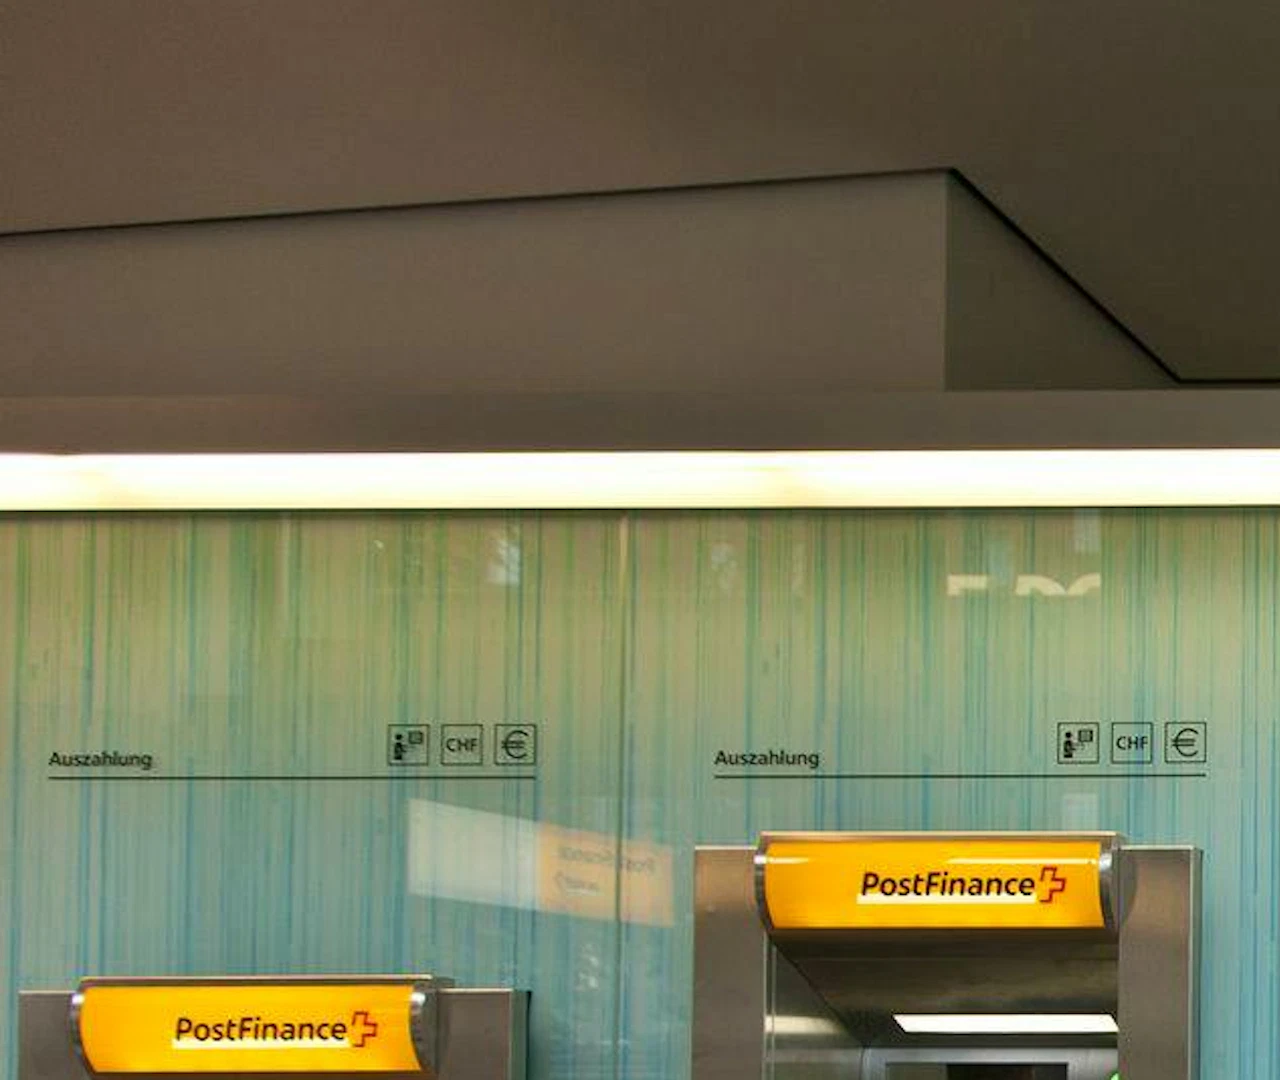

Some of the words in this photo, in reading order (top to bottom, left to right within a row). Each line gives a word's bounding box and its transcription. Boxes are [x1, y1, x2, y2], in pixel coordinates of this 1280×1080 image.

[445, 737, 479, 753] CHF
[1116, 735, 1149, 751] CHF
[48, 749, 153, 770] Auszahlung
[714, 748, 820, 770] Auszahlung
[861, 871, 1035, 897] PostFinance
[175, 1016, 347, 1042] PostFinance
